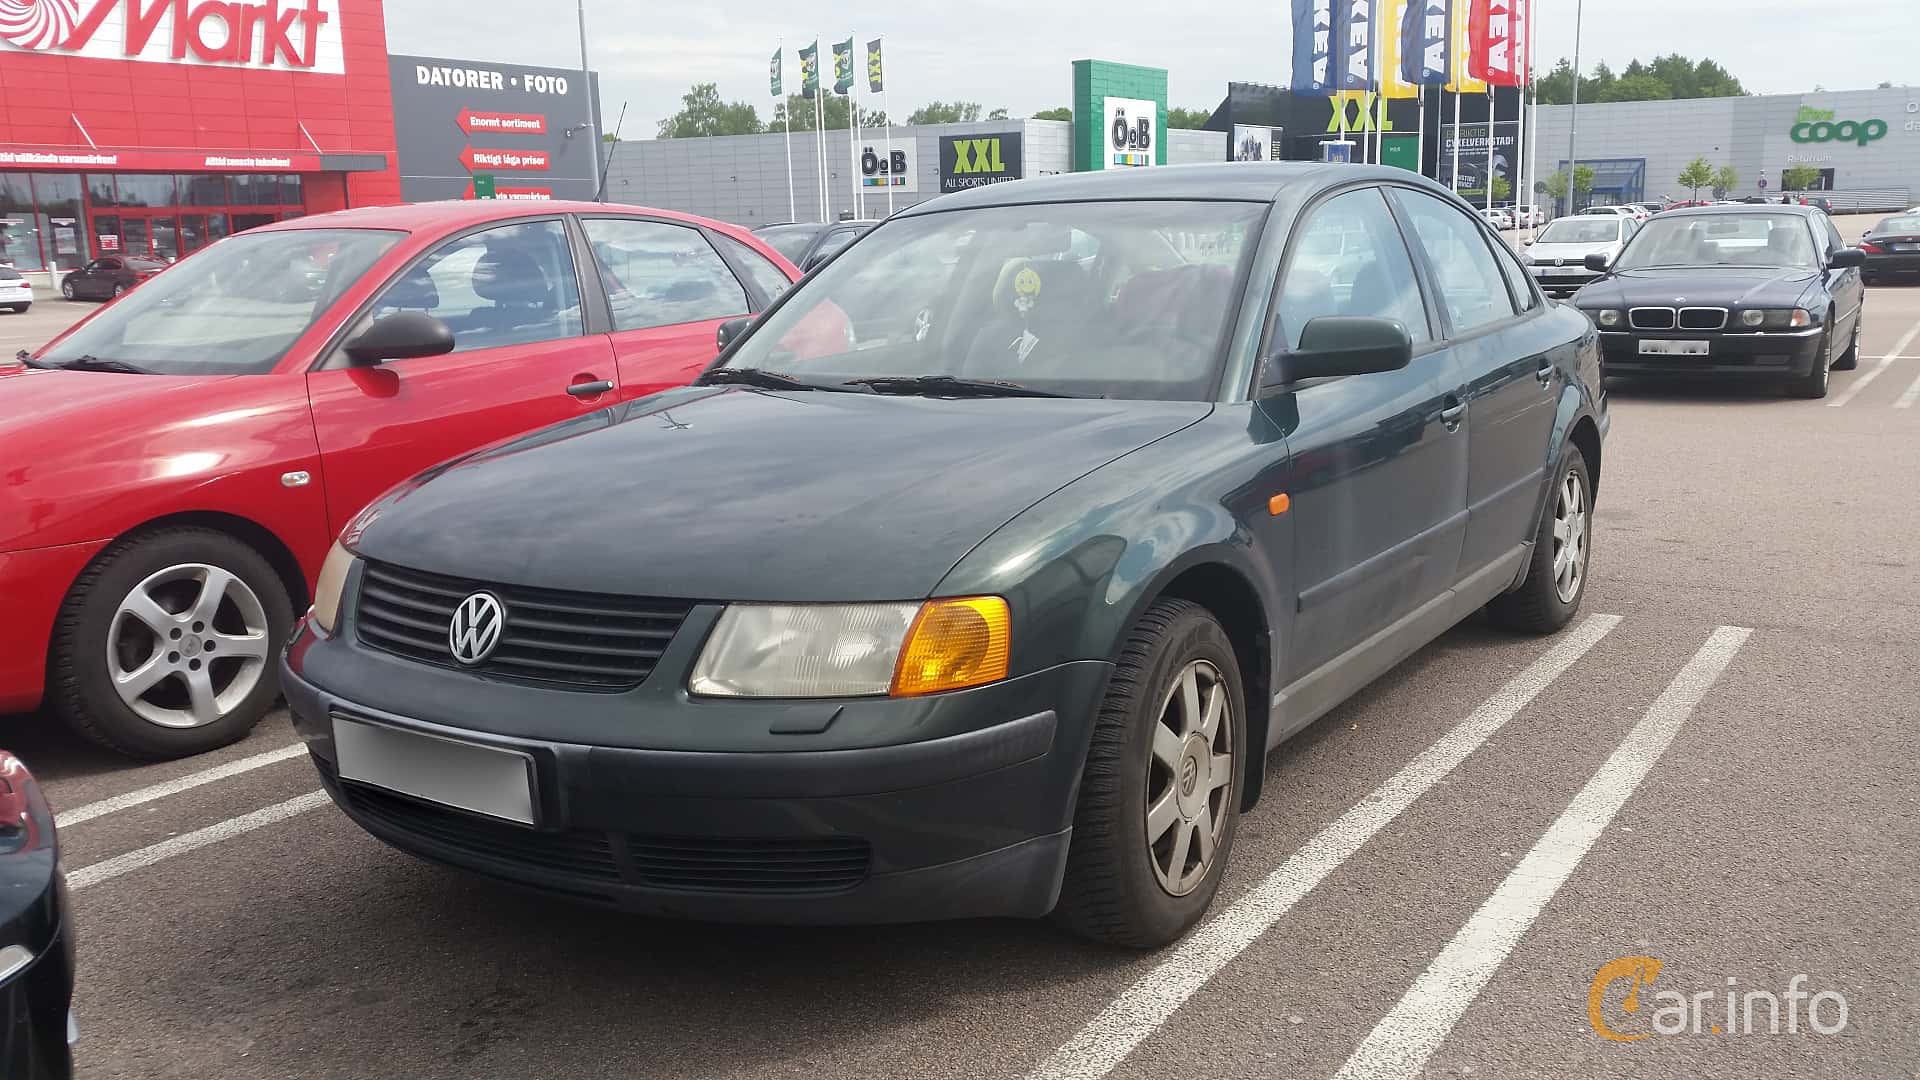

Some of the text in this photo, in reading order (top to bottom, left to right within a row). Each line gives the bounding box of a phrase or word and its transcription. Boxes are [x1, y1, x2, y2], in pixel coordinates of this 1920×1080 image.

[416, 65, 568, 95] DATORER FOTO
[470, 116, 540, 129] Enormt sortiment
[1327, 91, 1393, 132] XXL
[1112, 107, 1151, 151] ÖoB
[1790, 118, 1888, 147] coop
[473, 153, 545, 167] Riktigt låga priser
[953, 138, 1005, 174] XXL
[945, 178, 957, 188] ALL
[958, 177, 985, 188] SPORTS
